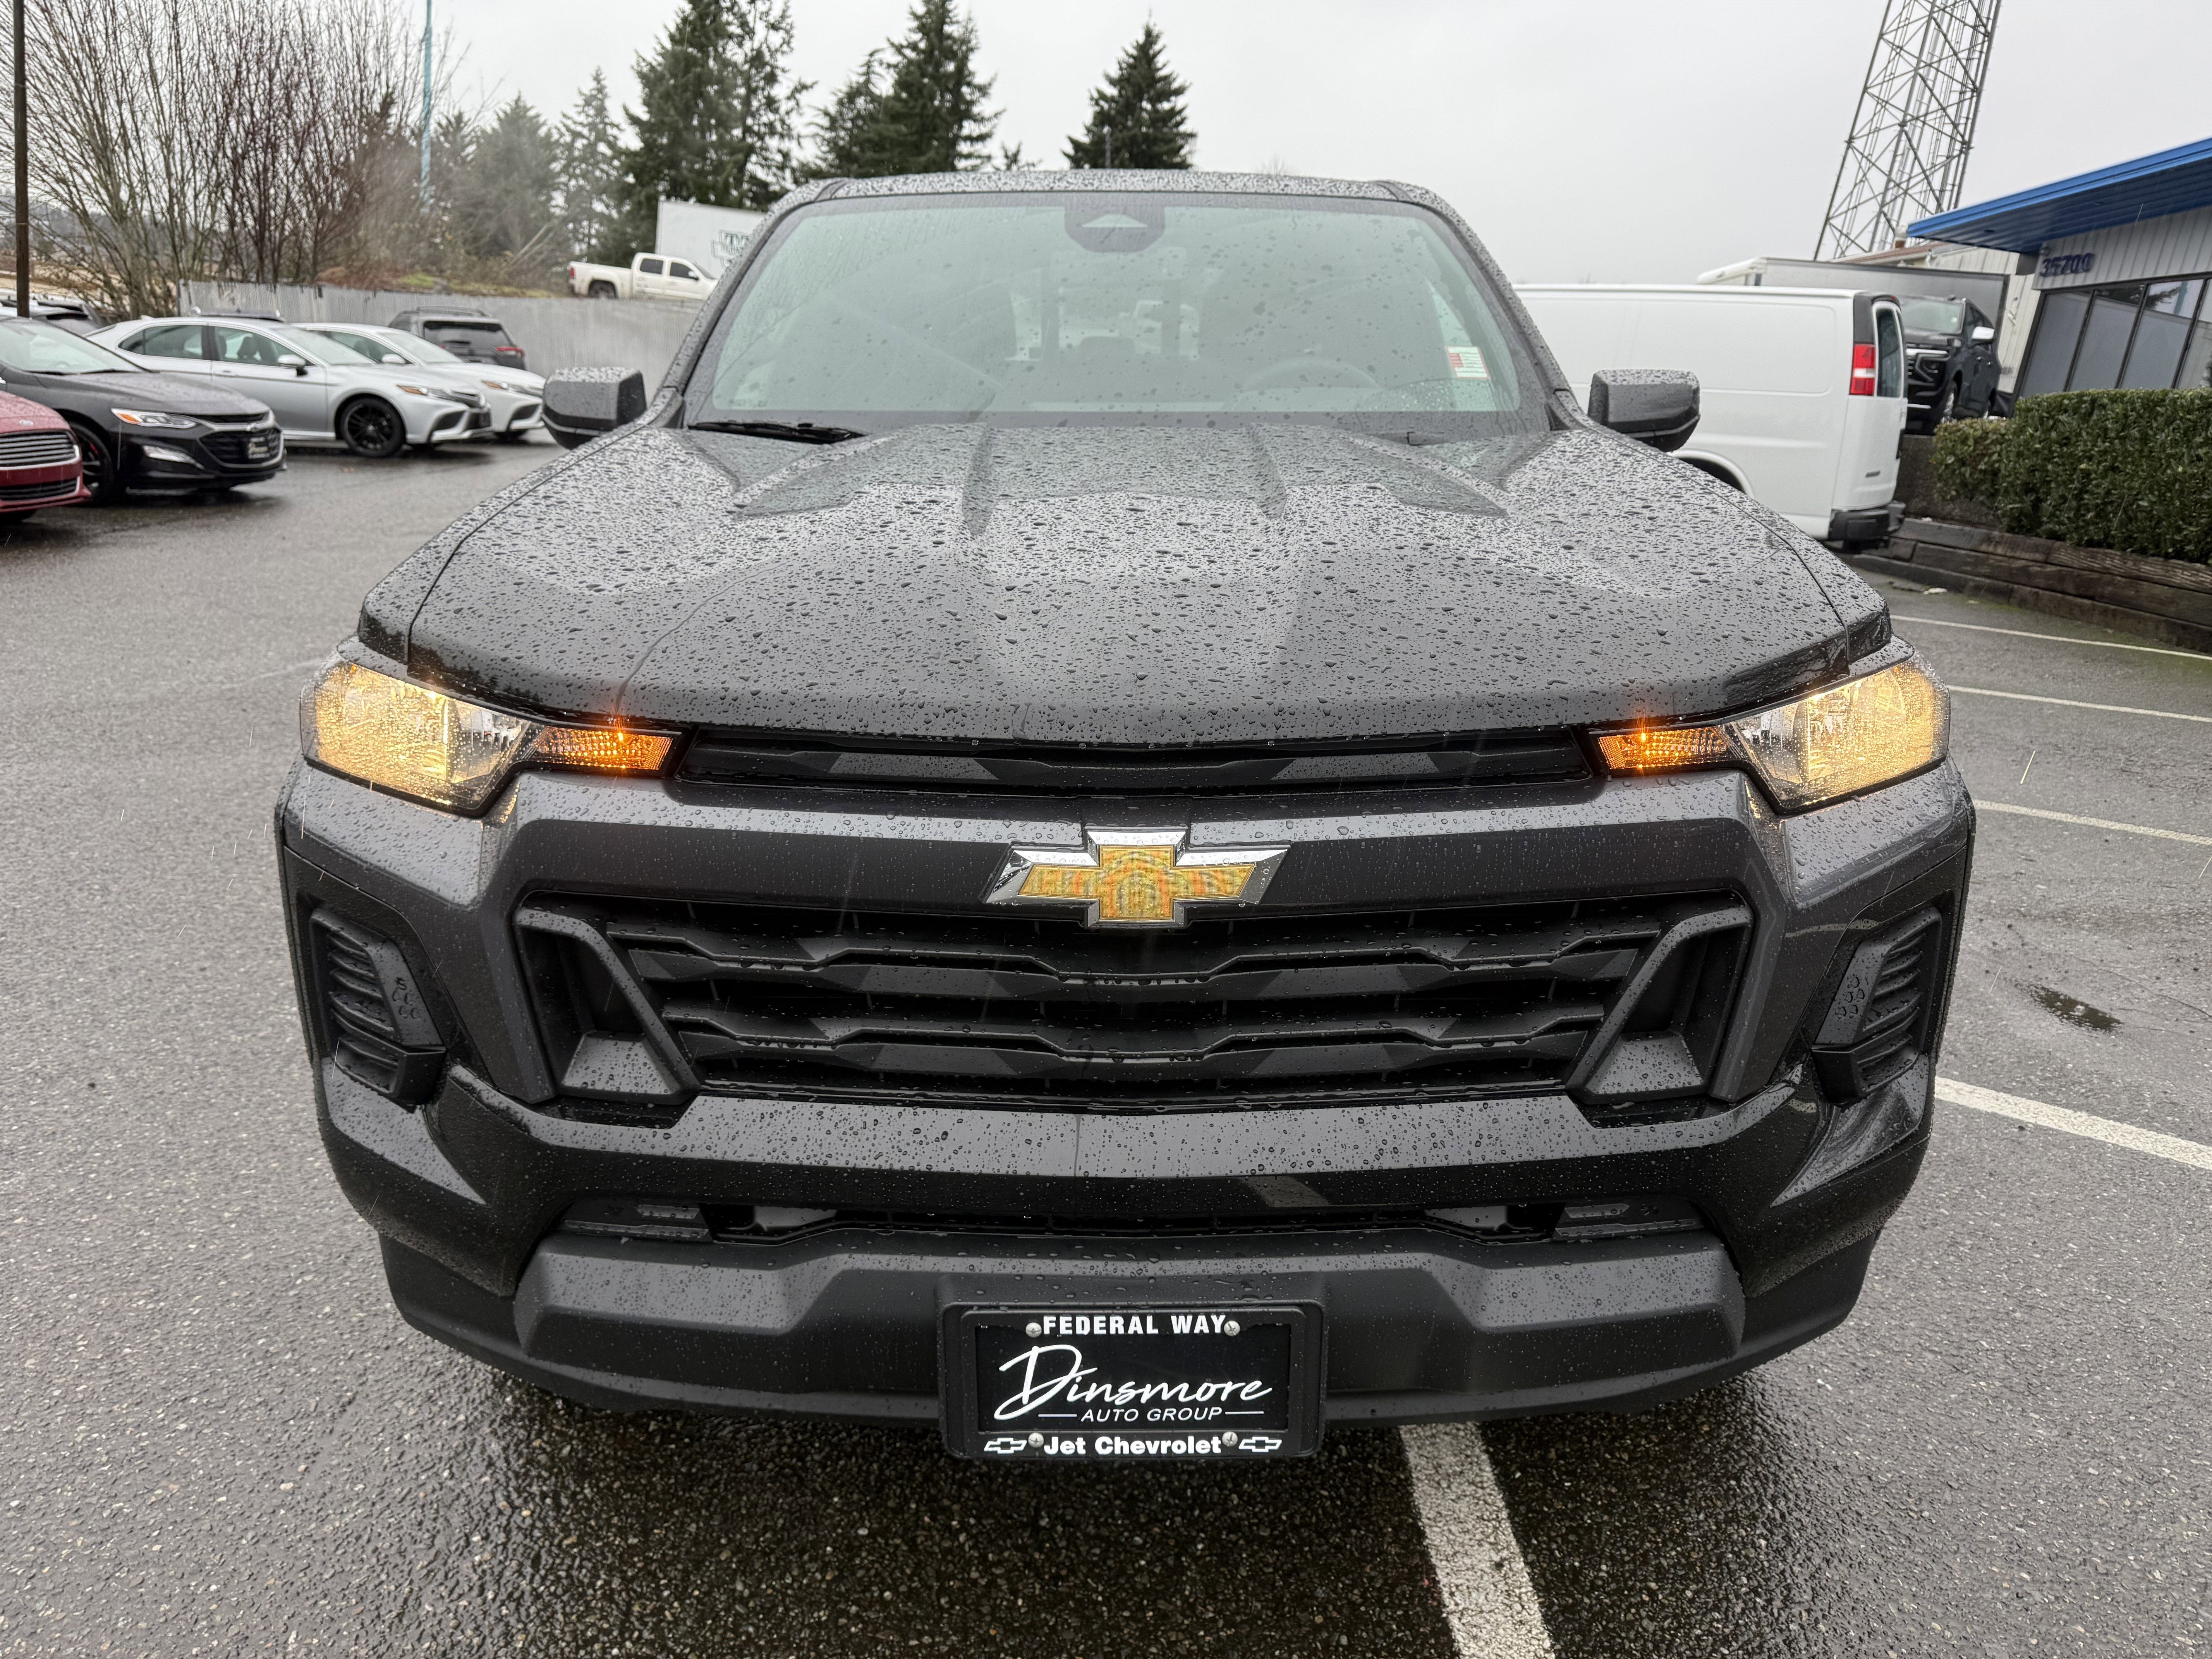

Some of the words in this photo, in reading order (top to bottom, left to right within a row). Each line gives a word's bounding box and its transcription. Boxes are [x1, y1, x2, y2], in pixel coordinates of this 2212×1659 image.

[2040, 253, 2094, 277] 35700
[1043, 1316, 1159, 1335] FEDERAL
[1171, 1315, 1226, 1334] WAY
[993, 1344, 1273, 1420] Dinsmore
[1080, 1408, 1139, 1422] AUTO
[1147, 1407, 1223, 1421] GROUP
[1043, 1436, 1086, 1455] Jet
[1094, 1436, 1222, 1455] Chevrolet
